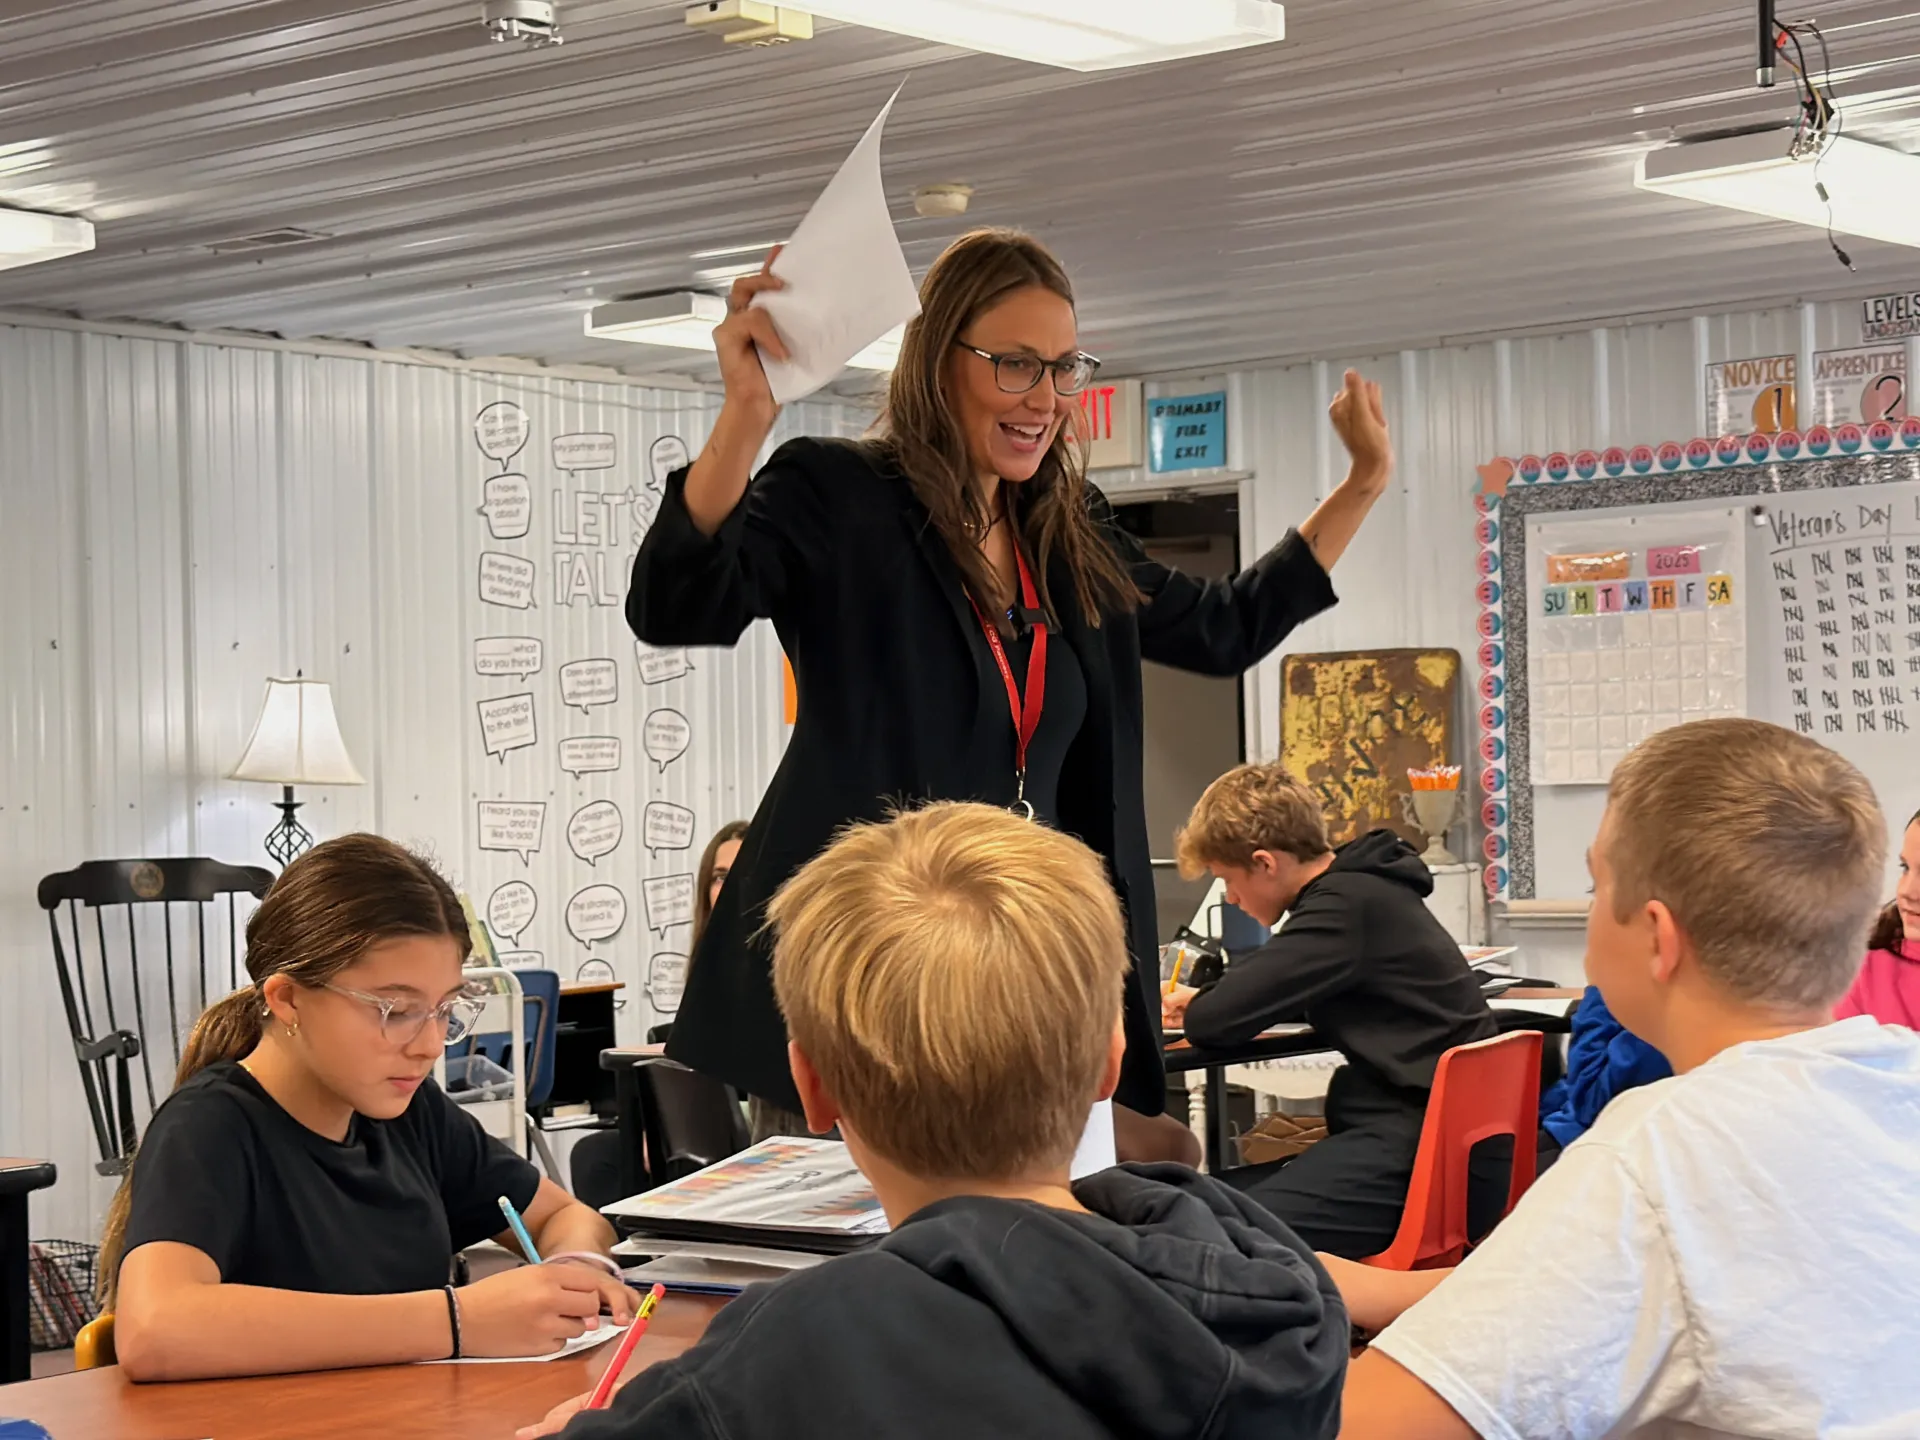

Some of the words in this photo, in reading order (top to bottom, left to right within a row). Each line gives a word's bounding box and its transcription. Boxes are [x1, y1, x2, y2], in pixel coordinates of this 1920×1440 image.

[1863, 294, 1920, 324] LEVELS
[1723, 356, 1796, 389] NOVICE
[1814, 351, 1905, 380] APPRENTICE
[1155, 400, 1222, 418] PRIMARY
[1774, 387, 1782, 428] 1
[1875, 376, 1902, 420] 2
[1175, 424, 1207, 438] FIRE
[1175, 445, 1208, 460] EXIT
[553, 485, 653, 546] LET'S
[1857, 503, 1892, 544] Day
[1654, 553, 1691, 570] 2025
[553, 551, 636, 607] TAL
[1544, 592, 1566, 612] SU
[1575, 591, 1588, 610] M
[1601, 588, 1613, 608] T
[1626, 586, 1642, 606] W
[1652, 586, 1673, 605] TH
[1685, 582, 1696, 603] F
[1707, 580, 1730, 601] SA
